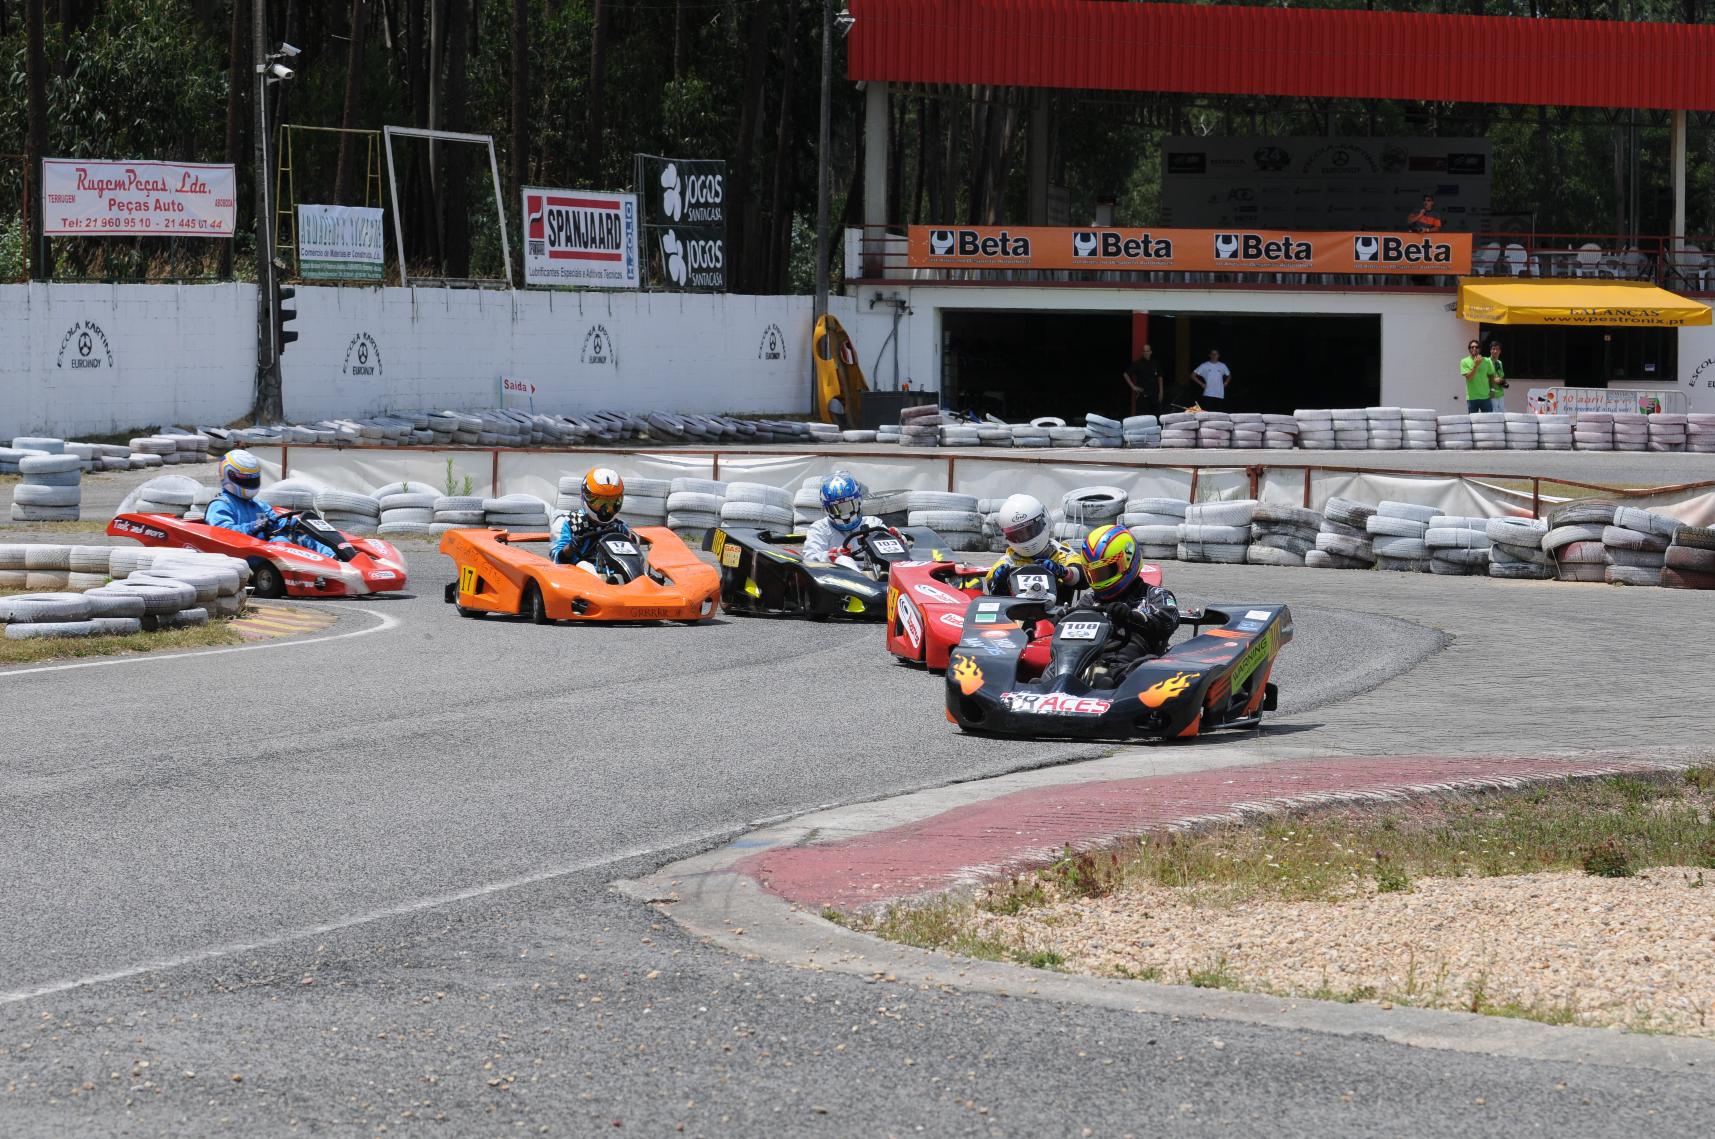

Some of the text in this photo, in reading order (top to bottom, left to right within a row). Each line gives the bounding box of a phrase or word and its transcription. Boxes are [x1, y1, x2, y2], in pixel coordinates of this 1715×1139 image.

[108, 198, 184, 214] Peças Auto
[684, 174, 723, 214] JOGOS
[61, 218, 82, 228] Tel:
[84, 218, 98, 228] 21
[101, 218, 121, 228] 960
[124, 218, 136, 228] 95
[139, 218, 151, 228] 10
[165, 218, 176, 228] 21
[178, 218, 196, 229] 445
[209, 219, 223, 229] 44
[547, 208, 622, 250] SPANJAARD
[957, 230, 1031, 257] Beta
[1101, 232, 1173, 259] Beta
[1242, 234, 1313, 262] Beta
[1382, 236, 1452, 264] Beta
[528, 266, 560, 277] Lubrificantes
[687, 240, 723, 279] JOGOS
[461, 567, 474, 592] 17
[1021, 575, 1044, 583] 74
